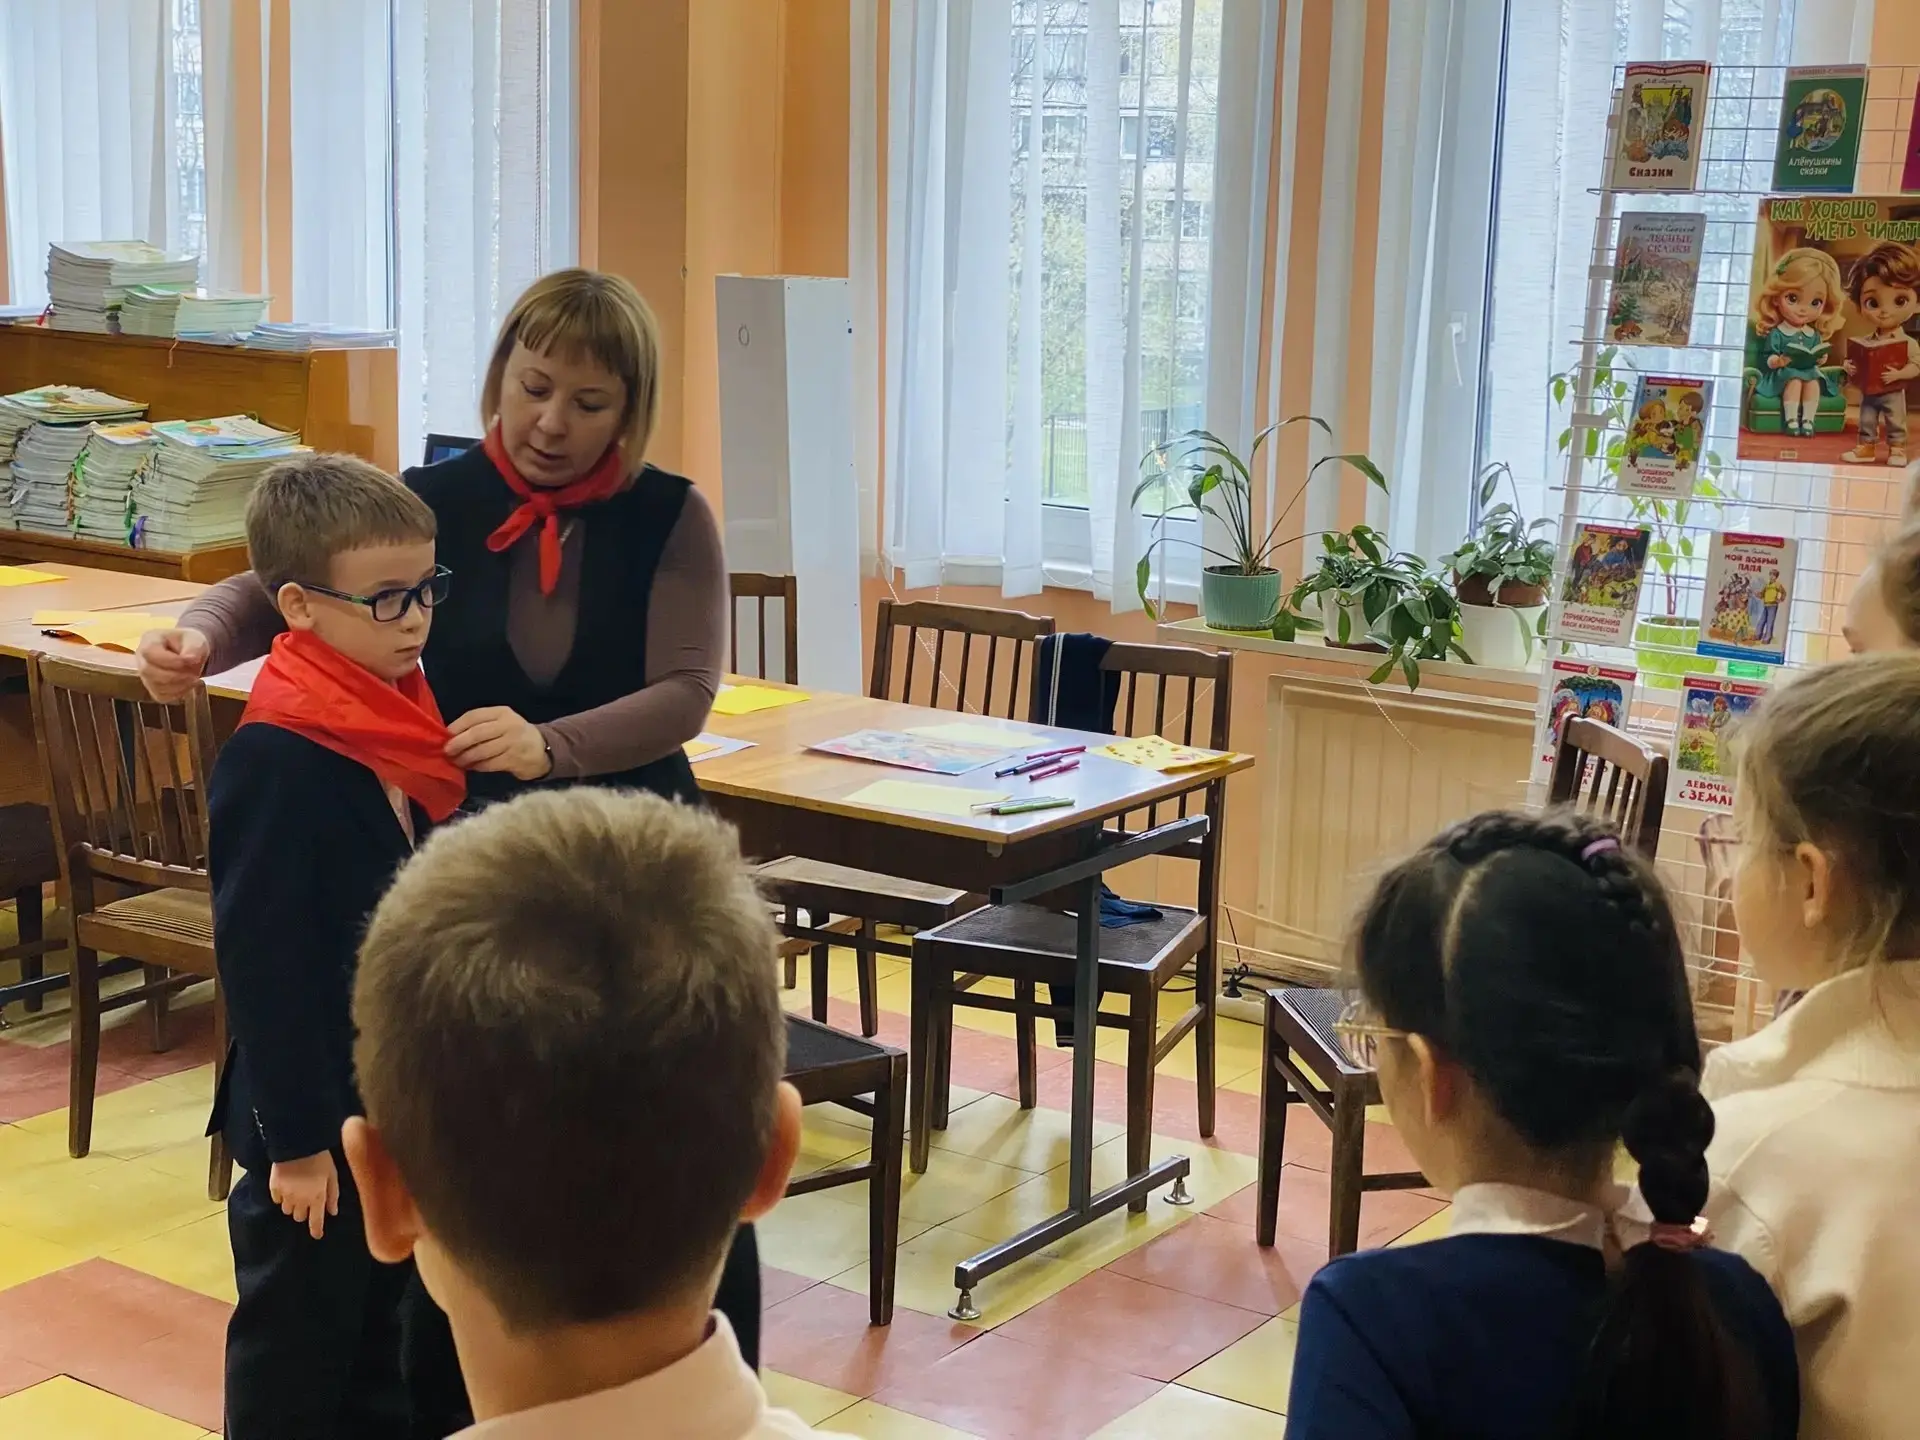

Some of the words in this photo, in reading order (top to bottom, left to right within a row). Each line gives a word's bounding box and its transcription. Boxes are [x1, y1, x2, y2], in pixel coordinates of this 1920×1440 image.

[1628, 167, 1673, 177] Сказки
[1770, 199, 1804, 221] КАК
[1808, 199, 1878, 221] ХОРОШО
[1805, 220, 1857, 240] УМЕТЬ
[1745, 556, 1779, 565] ДОБРЫЙ
[1738, 563, 1762, 573] ПАПА
[1563, 612, 1620, 626] ПРИКЛЮЧЕНИЯ
